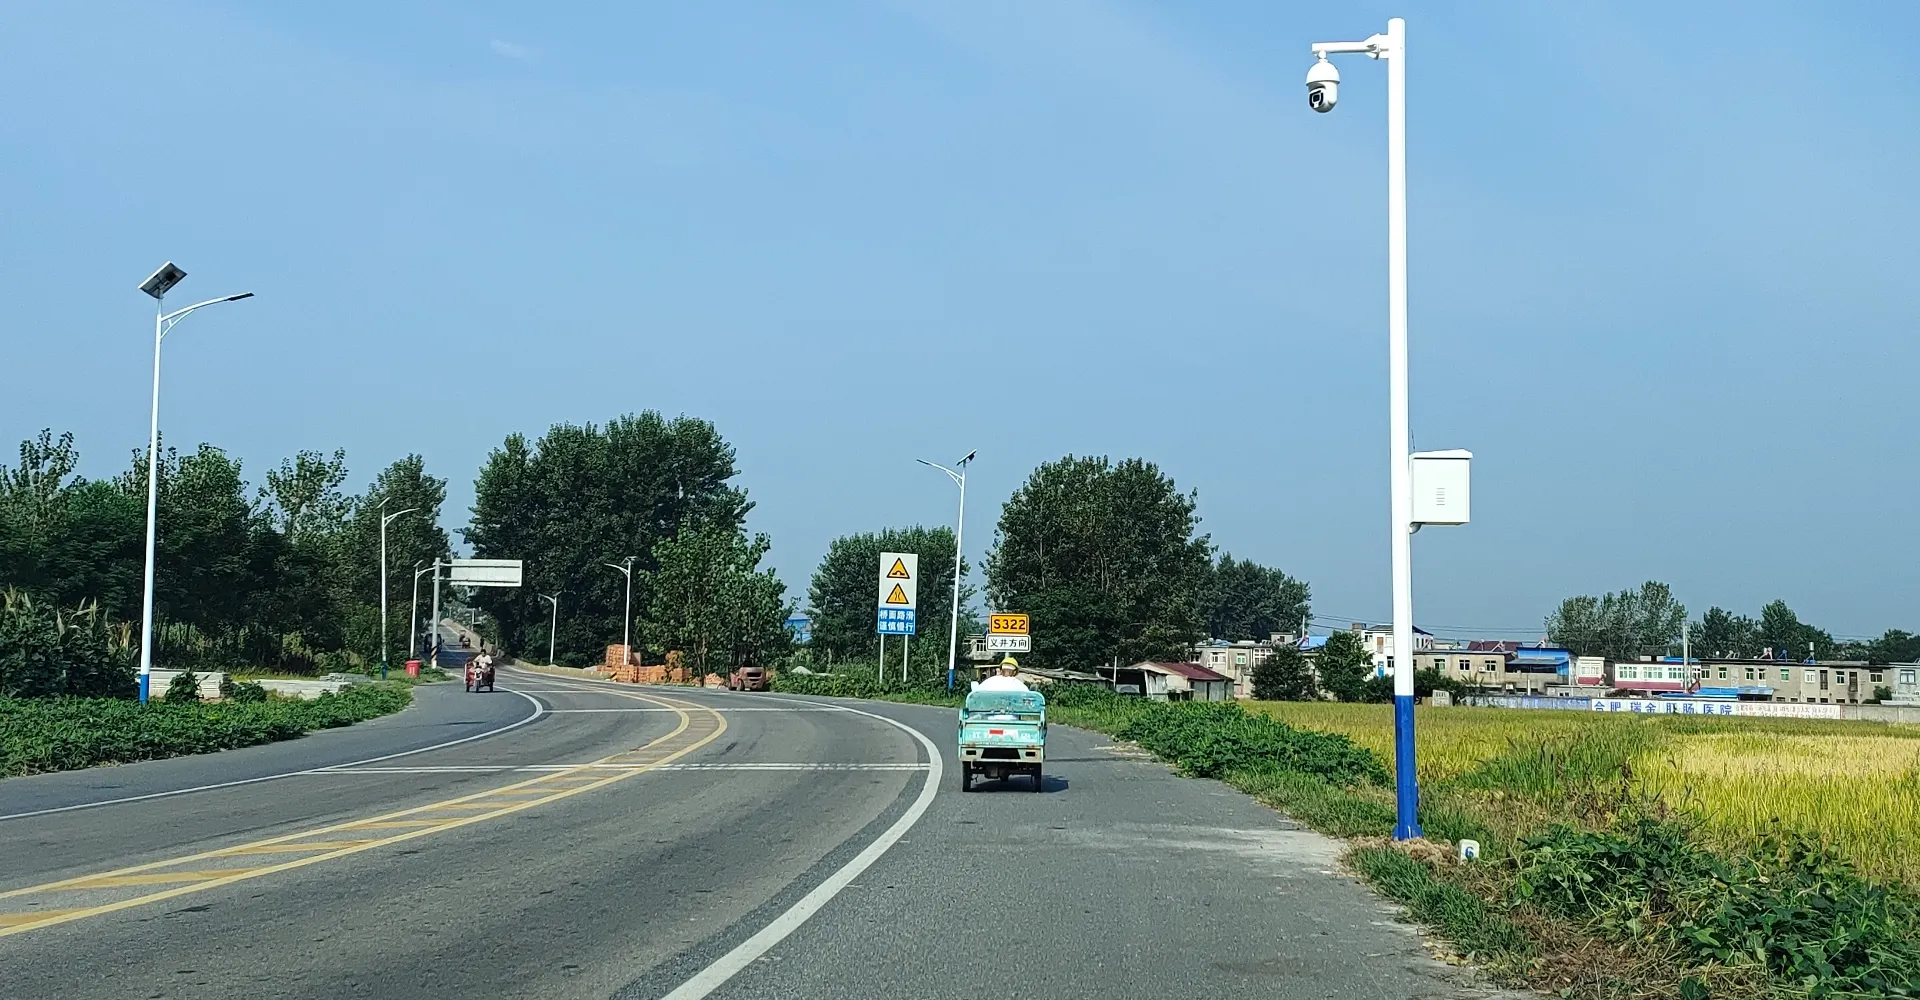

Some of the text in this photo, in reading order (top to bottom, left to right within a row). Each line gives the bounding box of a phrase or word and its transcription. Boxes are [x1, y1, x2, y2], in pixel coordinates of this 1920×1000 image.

[879, 610, 914, 621] 桥面路滑
[879, 621, 914, 632] 谨慎慢行
[993, 619, 1026, 630] S322
[990, 638, 1027, 648] 义井方向
[1465, 846, 1474, 861] 6
